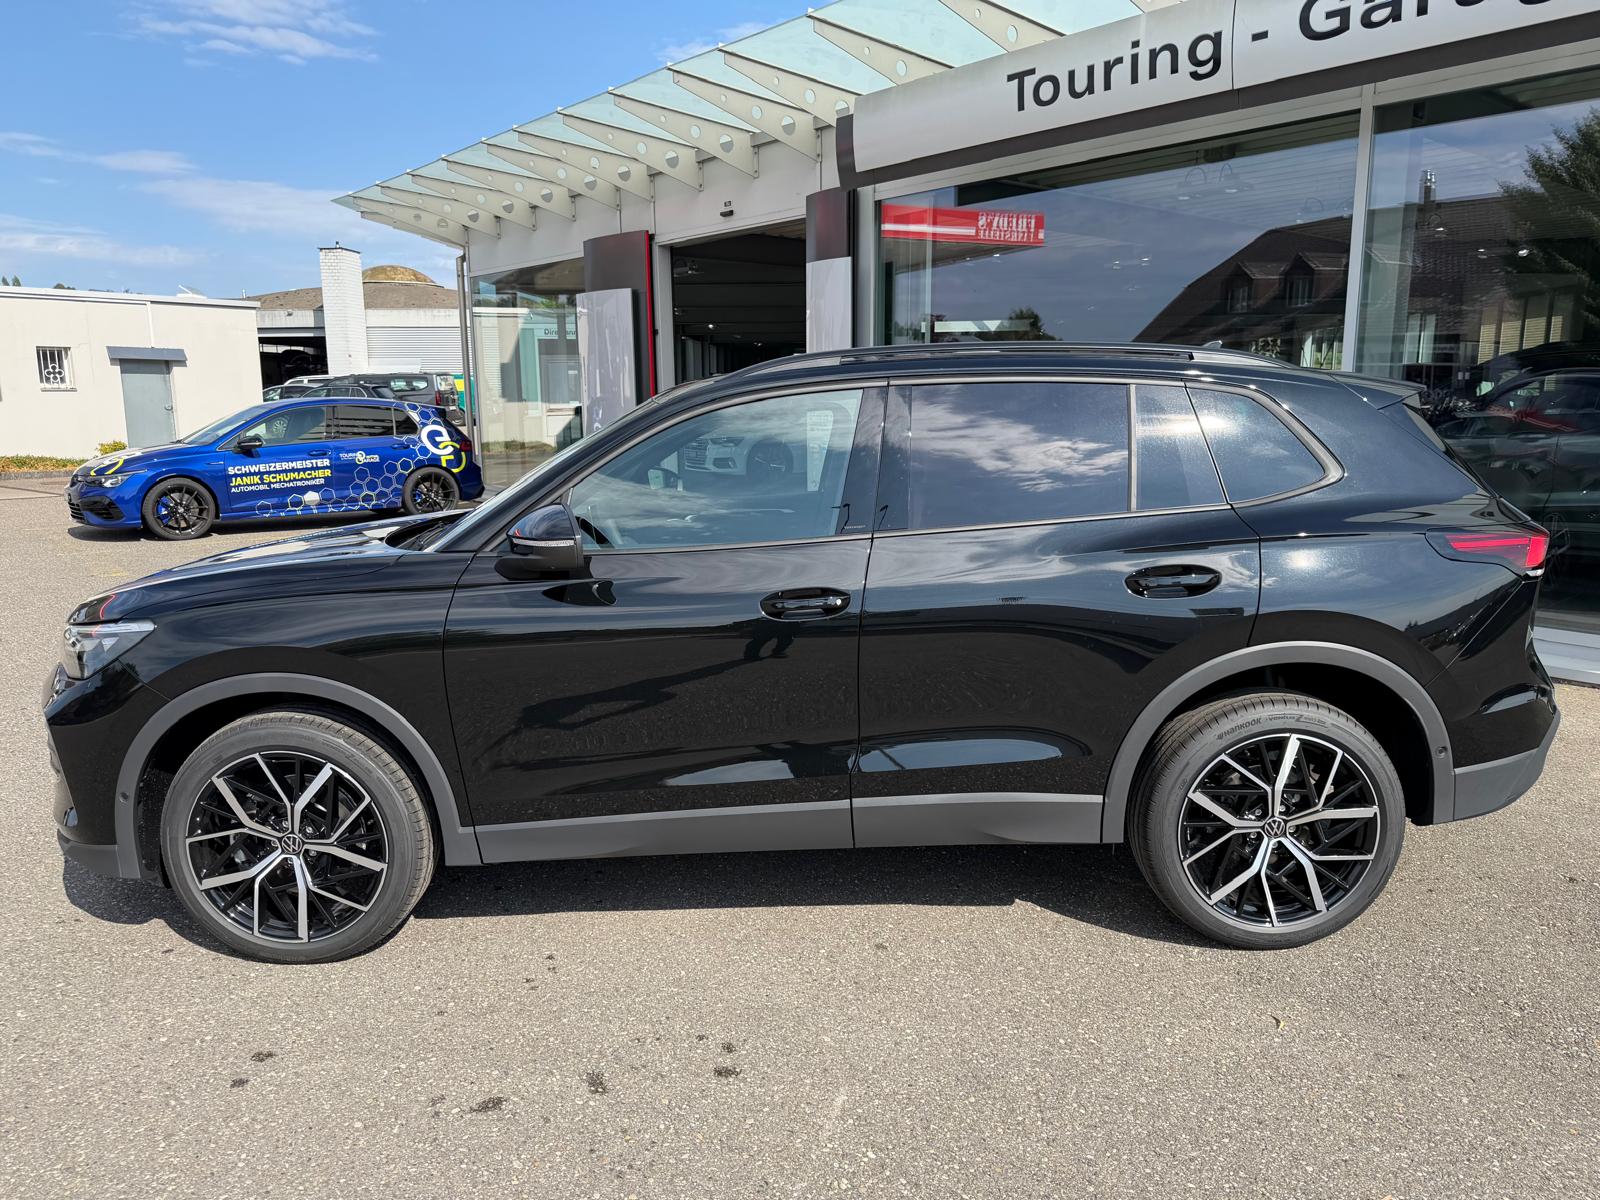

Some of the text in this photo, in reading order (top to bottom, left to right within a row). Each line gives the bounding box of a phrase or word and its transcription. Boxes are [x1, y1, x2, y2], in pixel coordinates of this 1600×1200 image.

[1007, 29, 1223, 112] Touring
[227, 459, 331, 475] SCHWEIZERMEISTER
[230, 469, 332, 486] JANIK SCHUMACHER
[230, 478, 325, 493] AUTOMOBIL MECHATRONIKER
